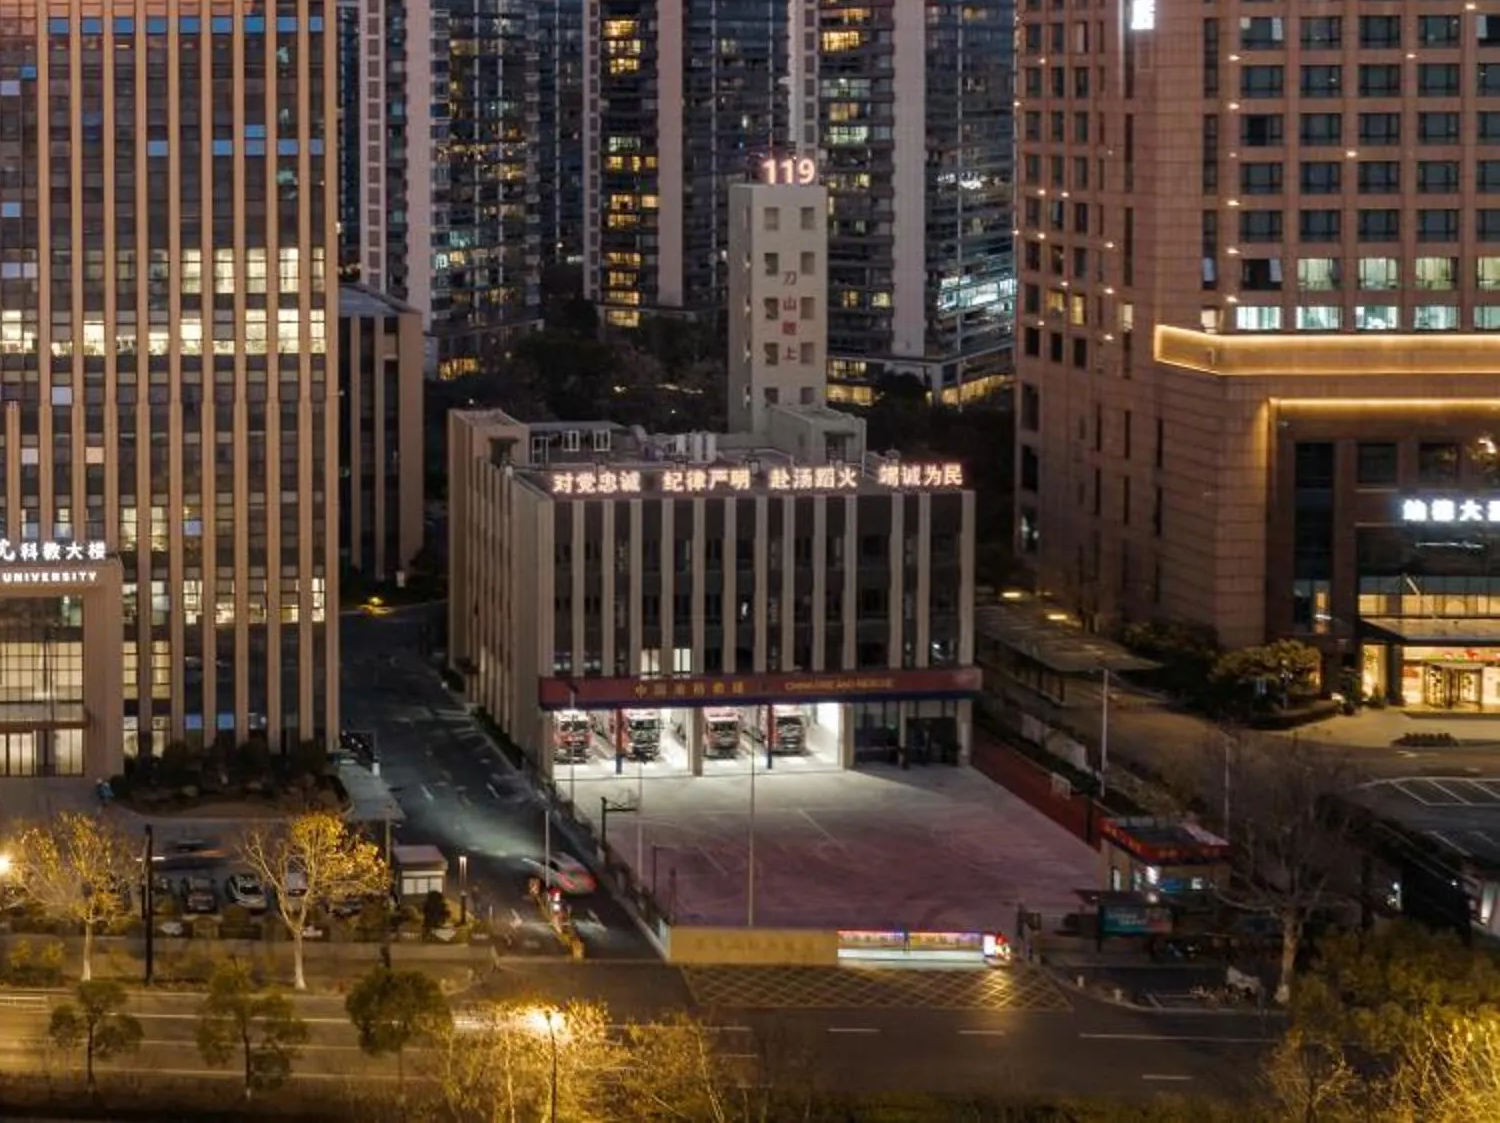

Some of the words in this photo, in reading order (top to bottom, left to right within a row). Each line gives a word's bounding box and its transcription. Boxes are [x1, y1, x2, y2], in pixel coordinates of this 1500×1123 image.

[762, 158, 816, 185] 119
[553, 471, 641, 494] 对党忠诚
[663, 469, 751, 492] 纪律严明
[769, 467, 857, 489] 赴汤蹈火
[2, 571, 97, 583] UNIVERSITY
